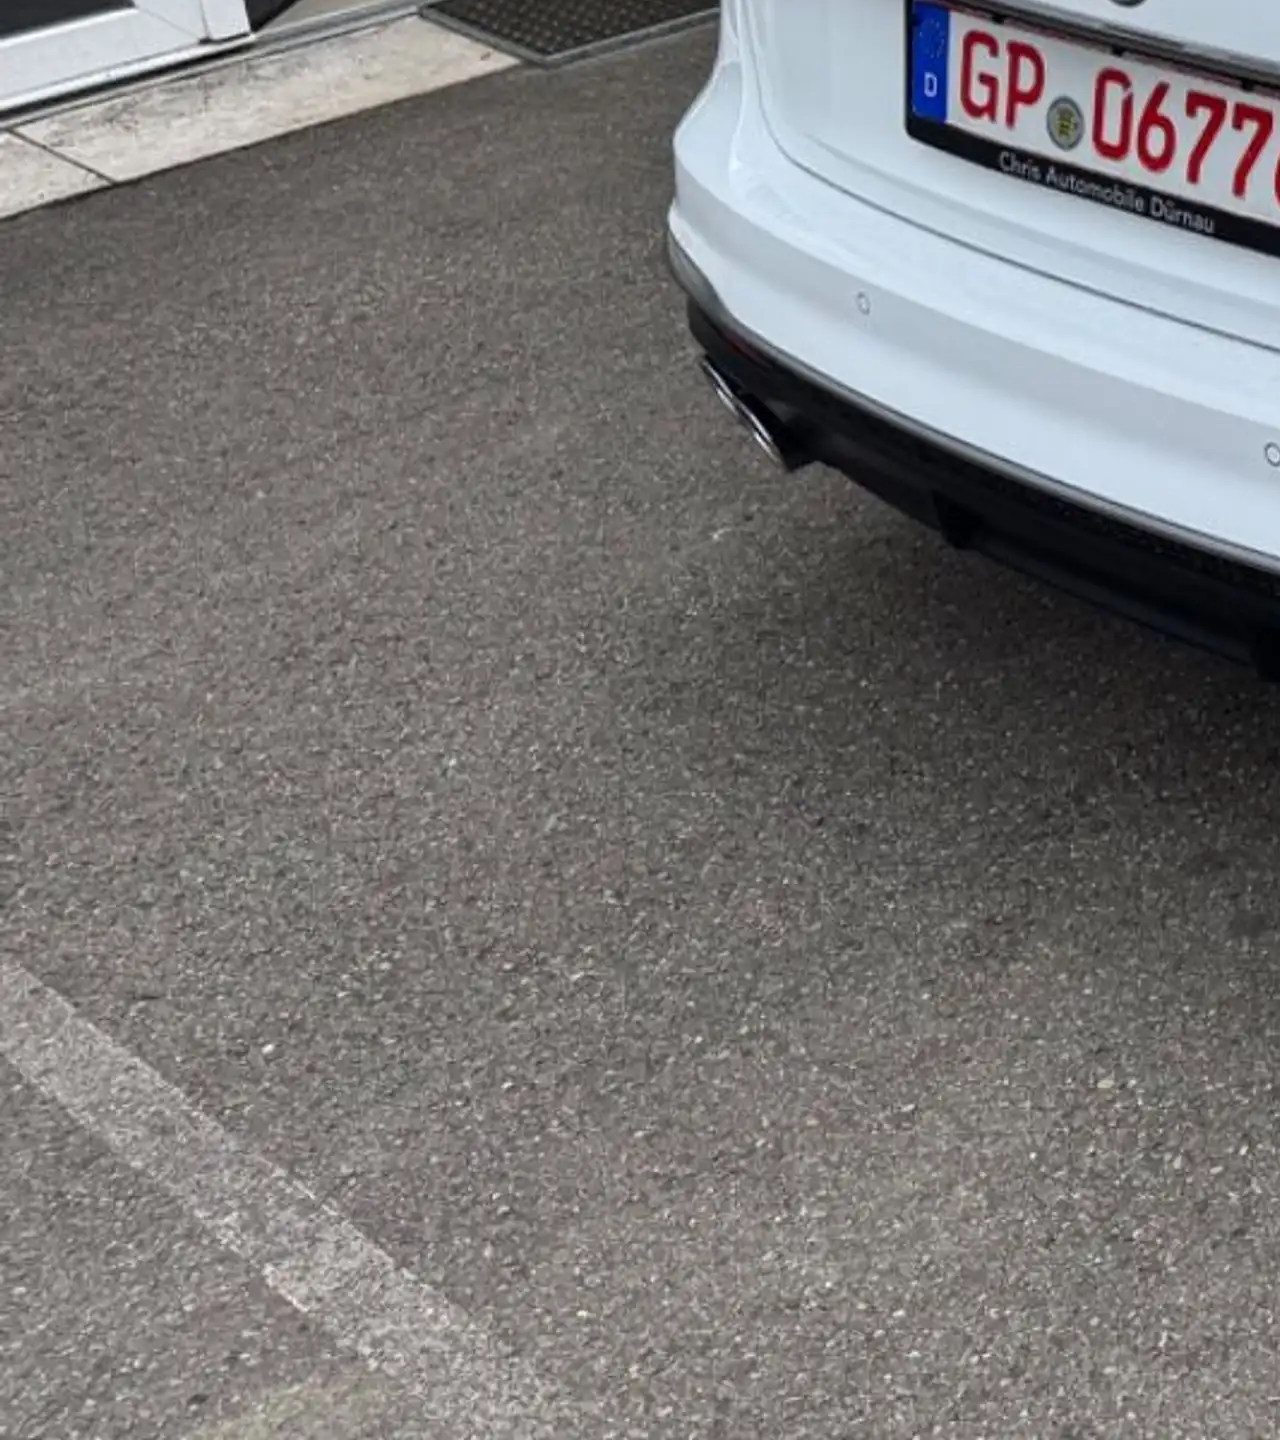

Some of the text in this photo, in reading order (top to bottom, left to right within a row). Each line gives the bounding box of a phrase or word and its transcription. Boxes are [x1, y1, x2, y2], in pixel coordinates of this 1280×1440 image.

[923, 73, 938, 98] D
[959, 29, 1046, 130] GP
[999, 150, 1216, 234] Chris Automobile Dürnau
